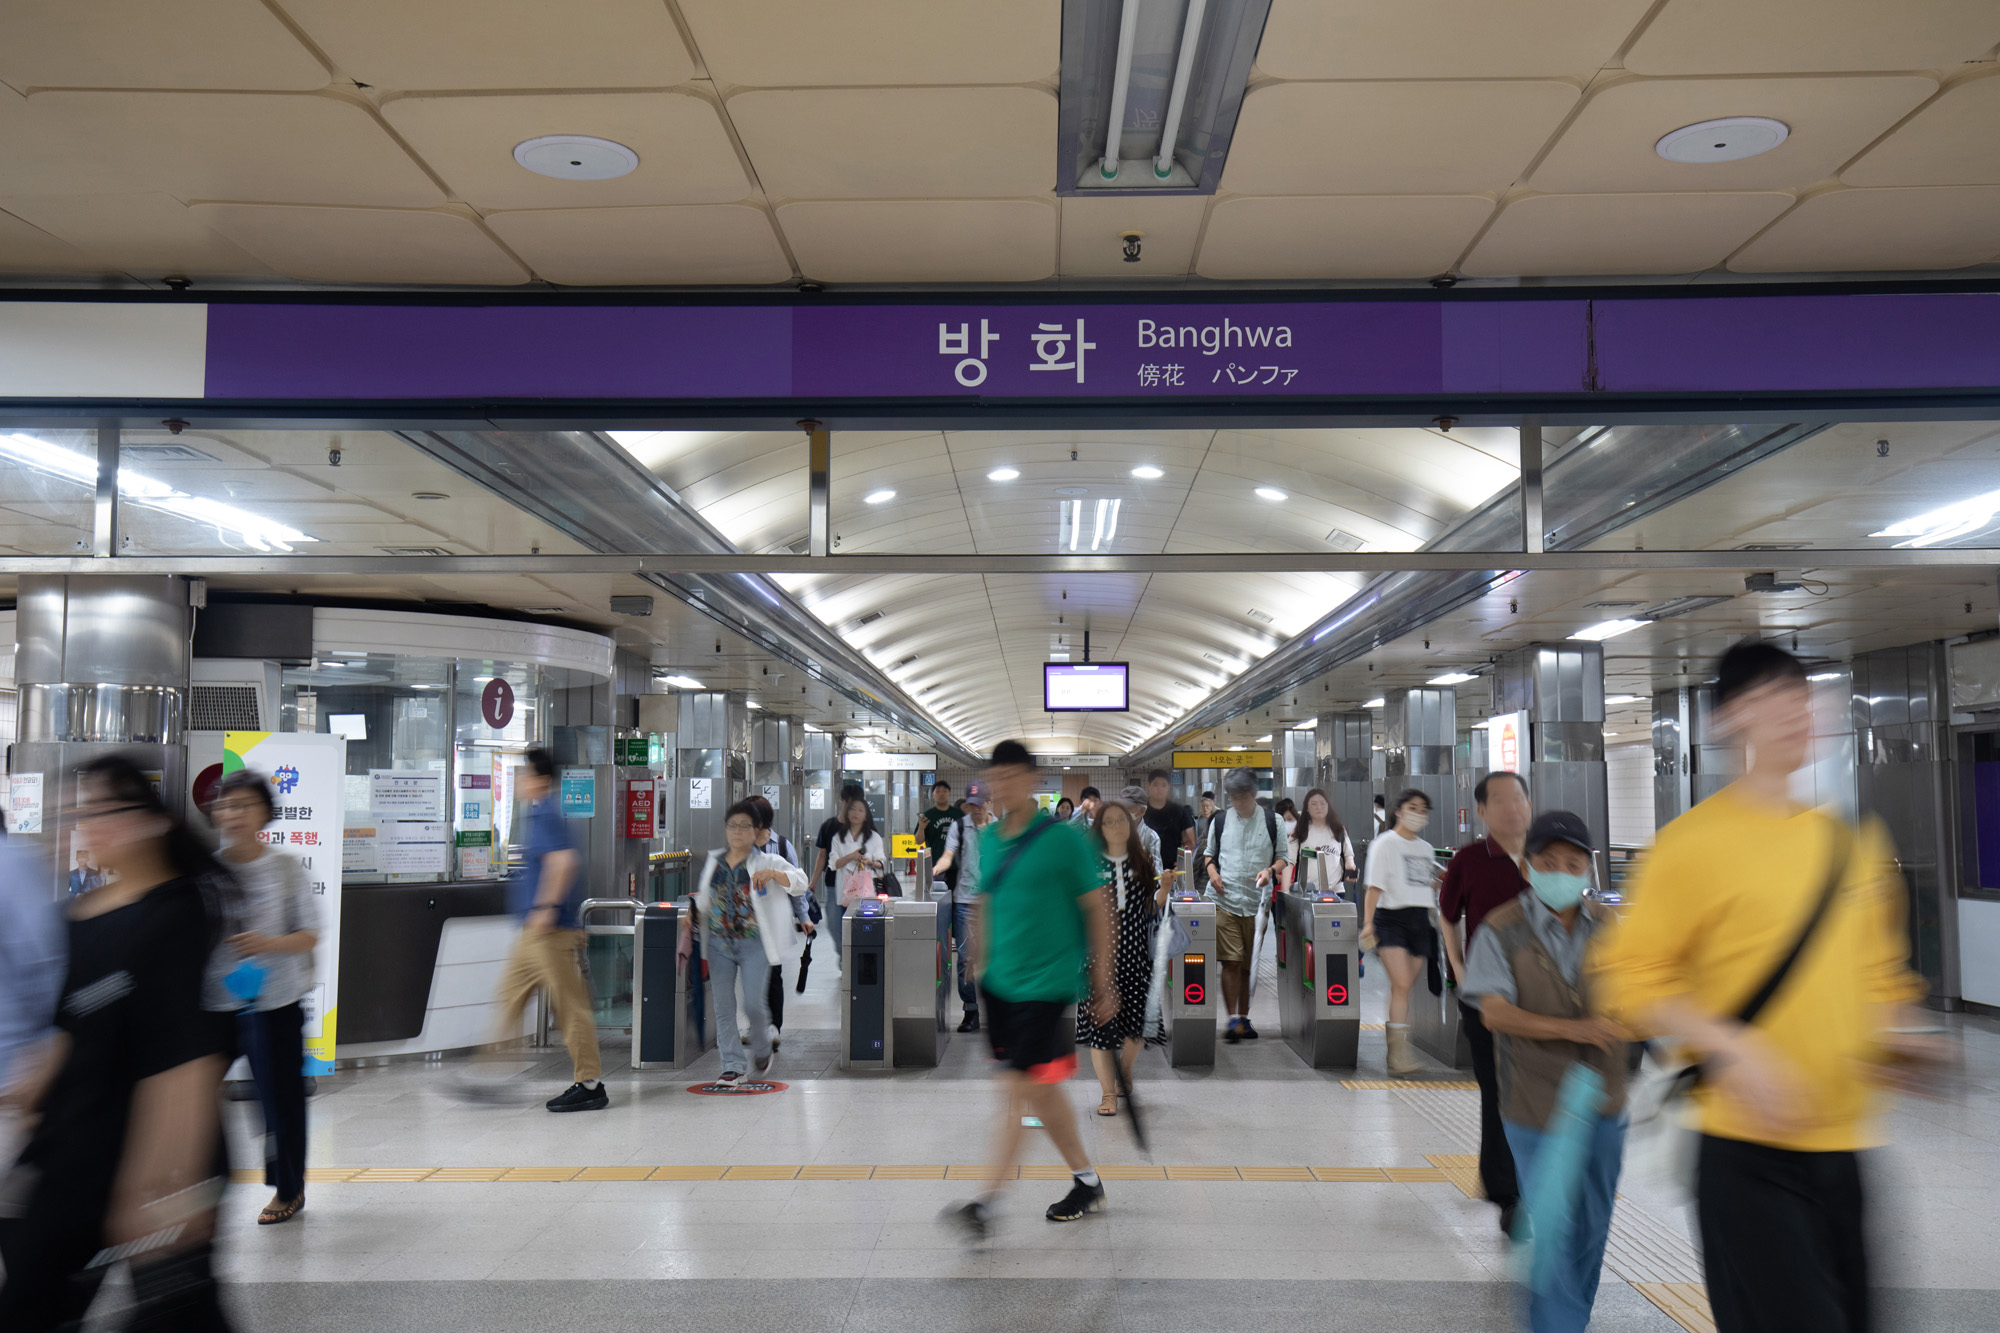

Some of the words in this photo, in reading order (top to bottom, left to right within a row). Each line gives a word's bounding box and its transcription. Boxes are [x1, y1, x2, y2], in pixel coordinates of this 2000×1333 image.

[1137, 318, 1292, 356] Banghwa
[1211, 362, 1299, 386] パンファ
[1210, 755, 1233, 764] 나오는
